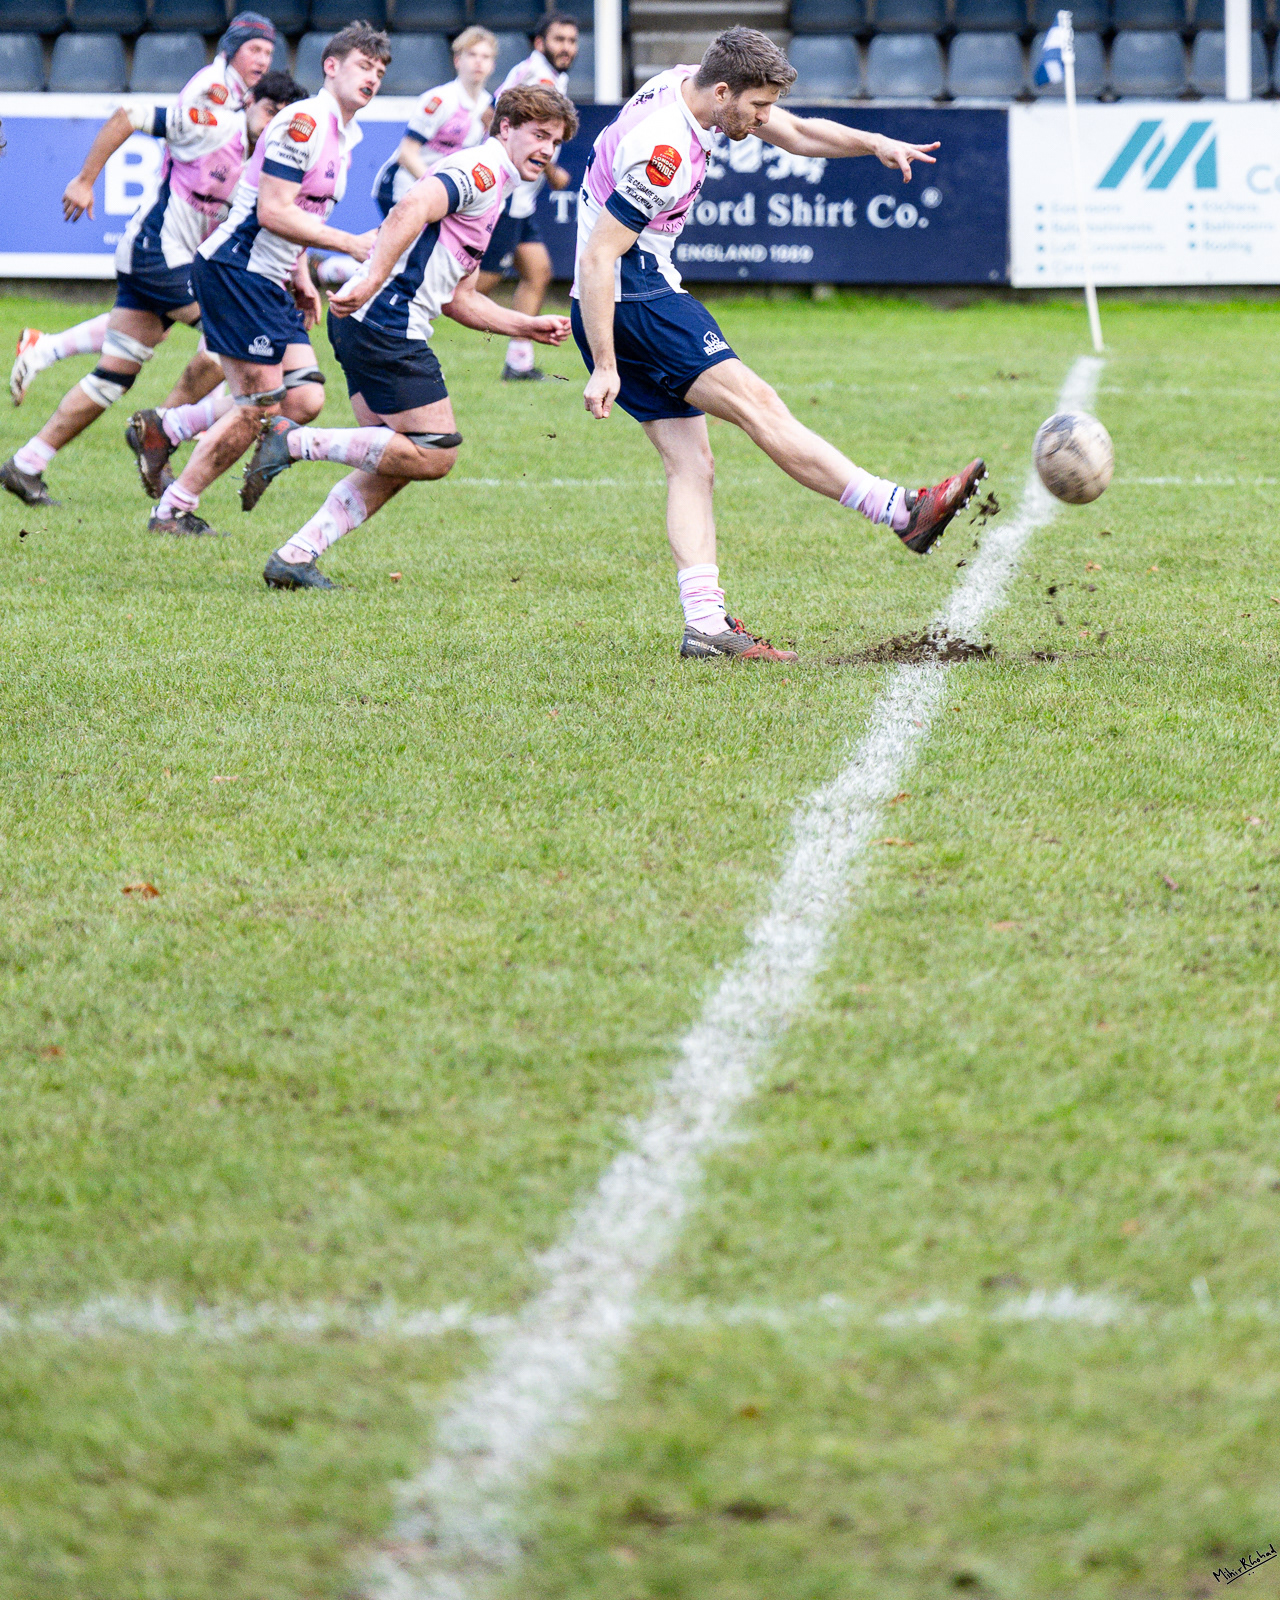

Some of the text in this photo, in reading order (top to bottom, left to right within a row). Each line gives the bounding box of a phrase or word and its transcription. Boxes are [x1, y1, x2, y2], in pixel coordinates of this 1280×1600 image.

[652, 160, 675, 180] PRIDE
[653, 156, 677, 171] LONDON
[768, 192, 857, 227] Shirt
[677, 243, 767, 262] ENGLAND
[687, 639, 725, 655] canterbur
